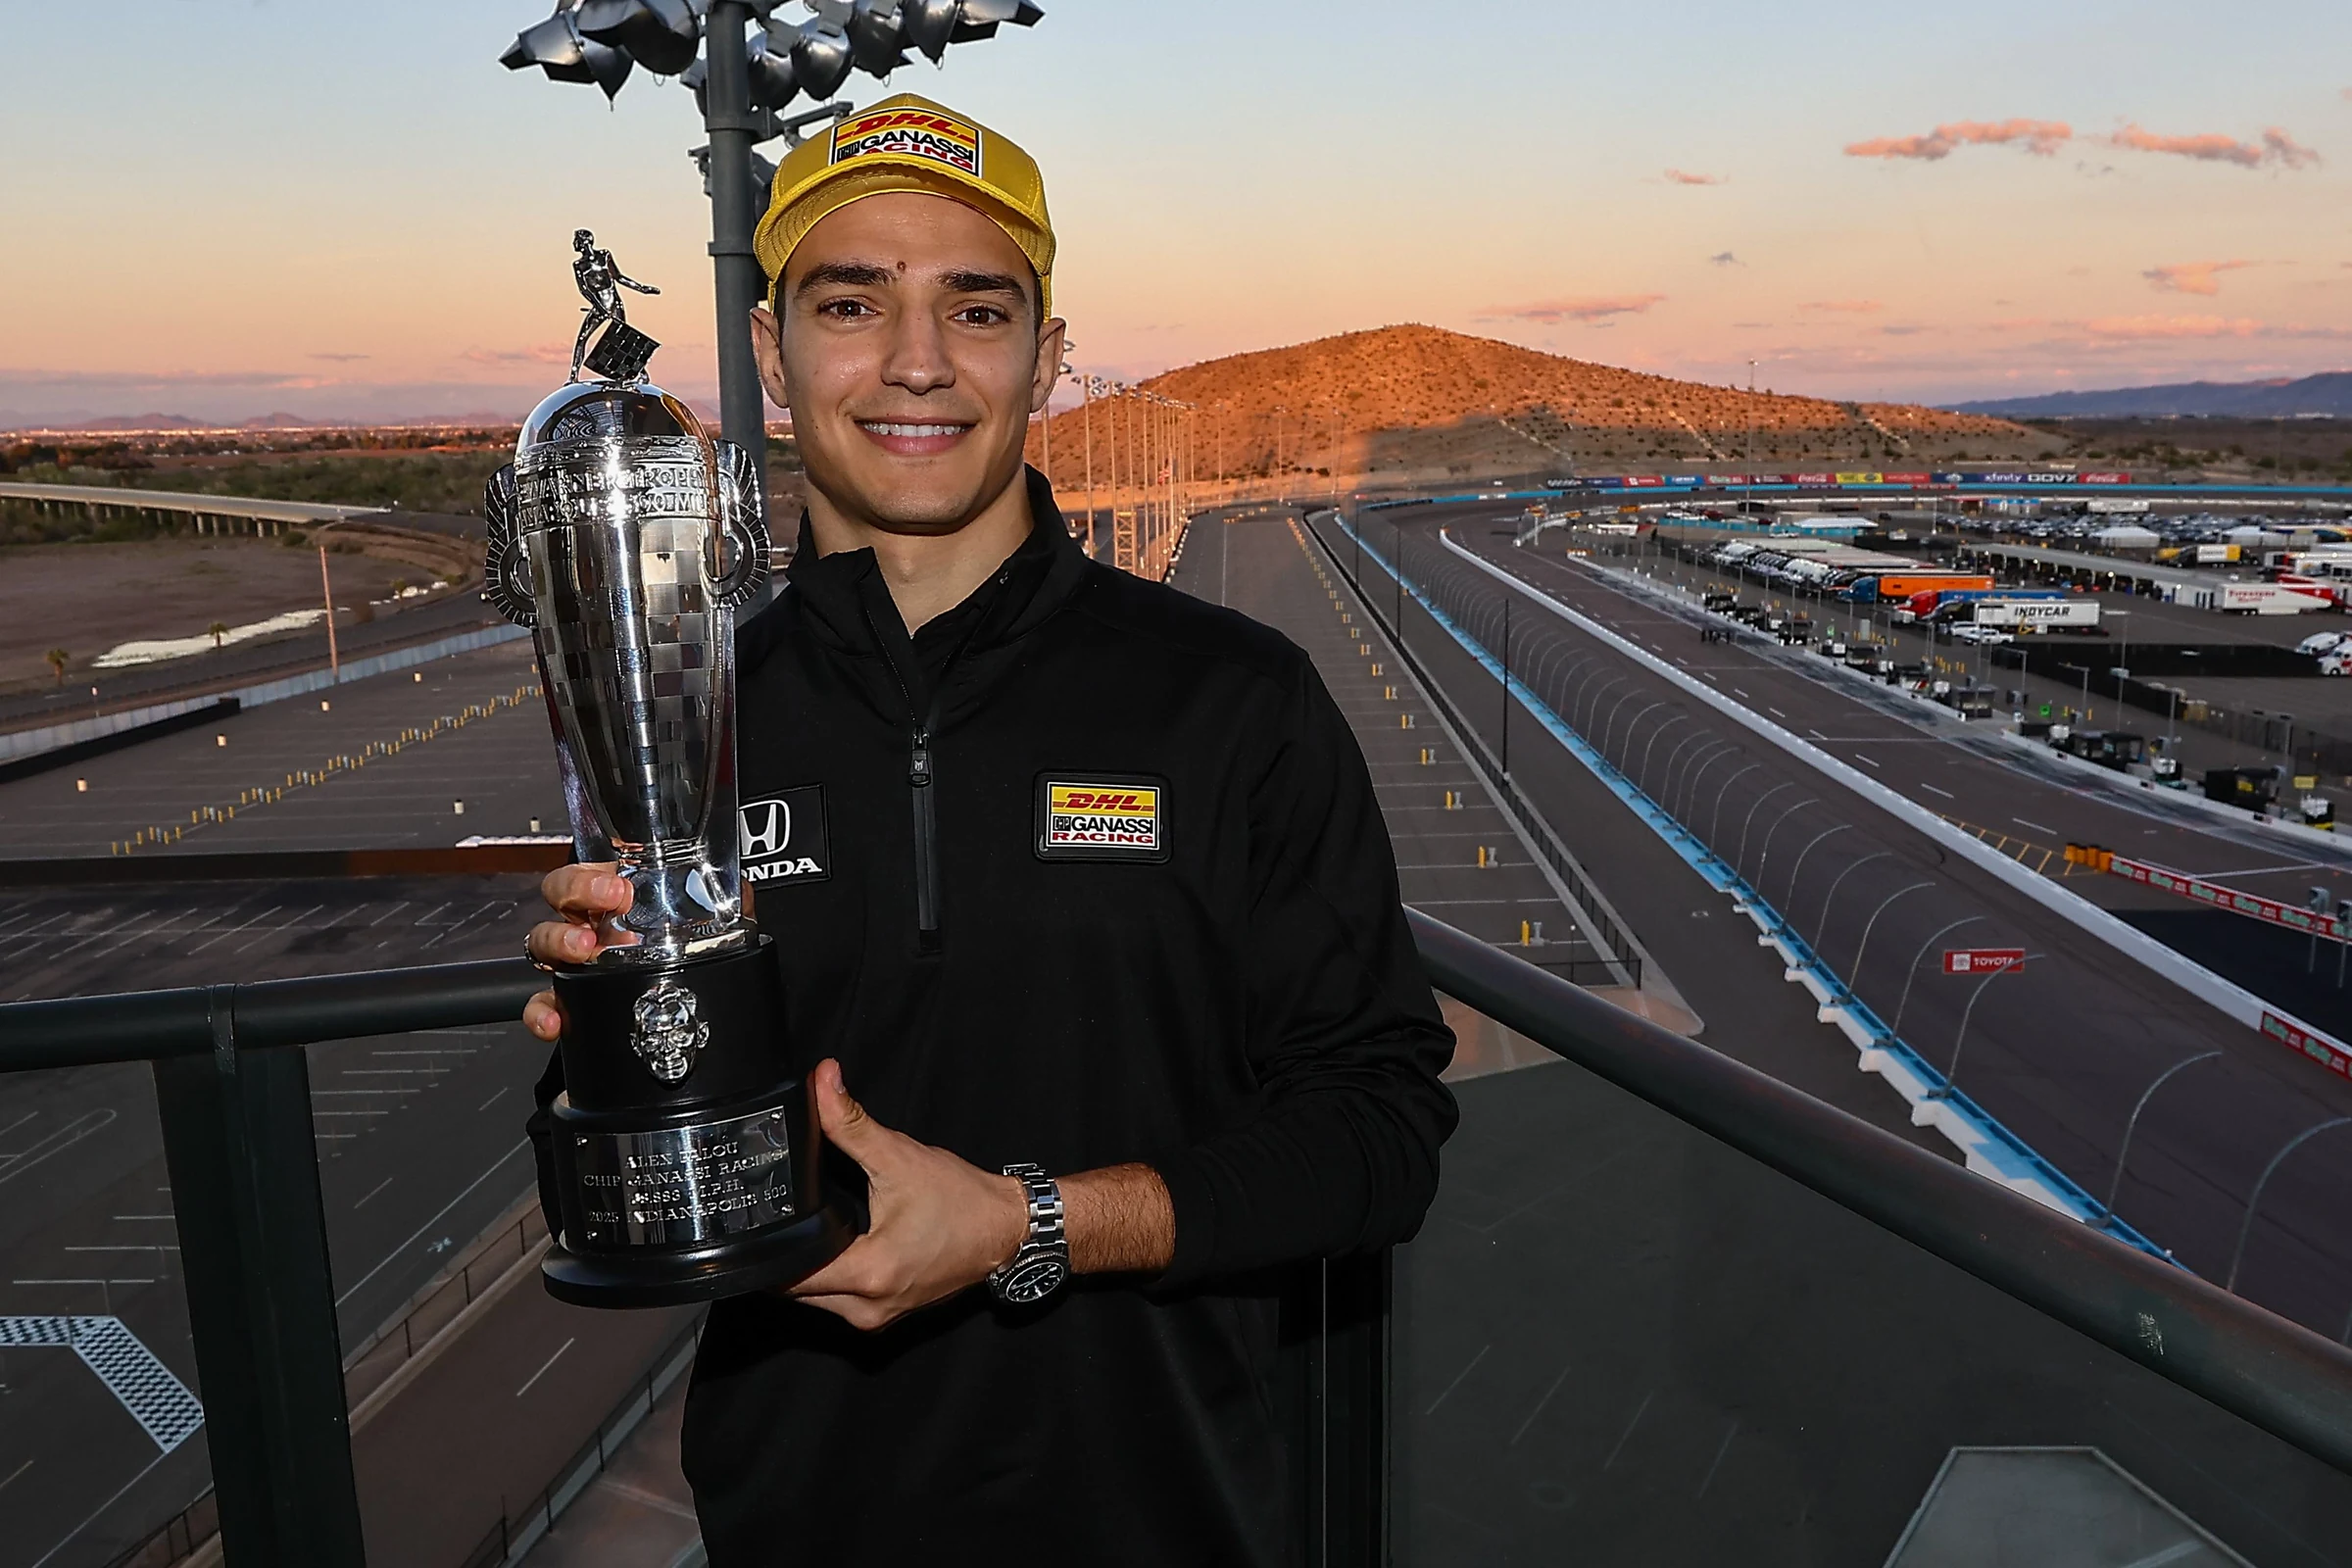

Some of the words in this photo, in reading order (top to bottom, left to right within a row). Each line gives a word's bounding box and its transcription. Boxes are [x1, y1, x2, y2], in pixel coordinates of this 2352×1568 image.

[852, 113, 959, 137] DHL
[839, 142, 974, 171] ACING
[859, 129, 974, 164] GANASSI
[2014, 606, 2071, 616] INDYCAR
[1064, 792, 1143, 811] DHL
[1071, 816, 1153, 834] GANASSI
[1052, 832, 1153, 844] RACING
[741, 857, 823, 882] NDA
[583, 1174, 621, 1187] CHIP
[627, 1165, 711, 1187] GANASSI
[717, 1148, 783, 1176] RACING
[624, 1152, 673, 1169] ALEX
[588, 1210, 619, 1223] 2025
[627, 1193, 759, 1223] INDIANAPOLIS
[763, 1183, 787, 1202] 500
